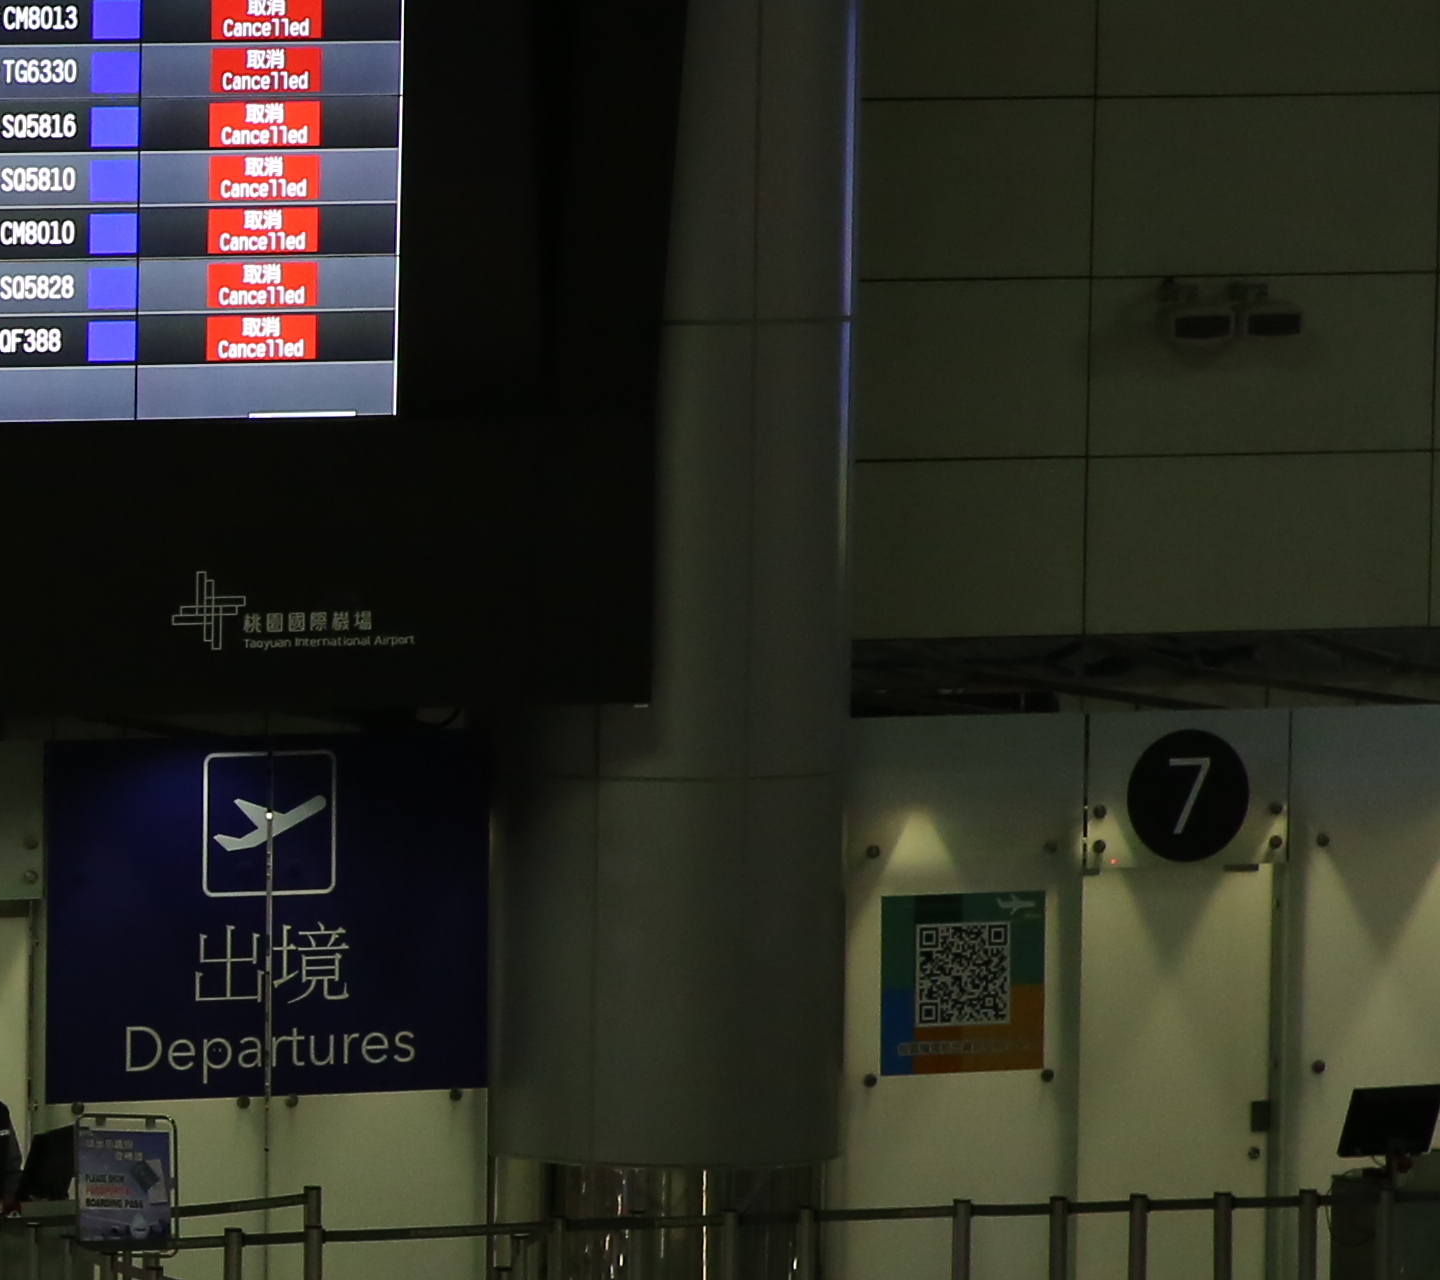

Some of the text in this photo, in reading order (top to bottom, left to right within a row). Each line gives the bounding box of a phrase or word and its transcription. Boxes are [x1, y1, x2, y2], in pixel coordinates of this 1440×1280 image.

[244, 611, 371, 632] 桃園國際機場
[244, 635, 415, 650] Taoyuan International Airport
[1169, 757, 1211, 834] 7
[194, 922, 350, 1005] 出境
[126, 1019, 415, 1087] Departures
